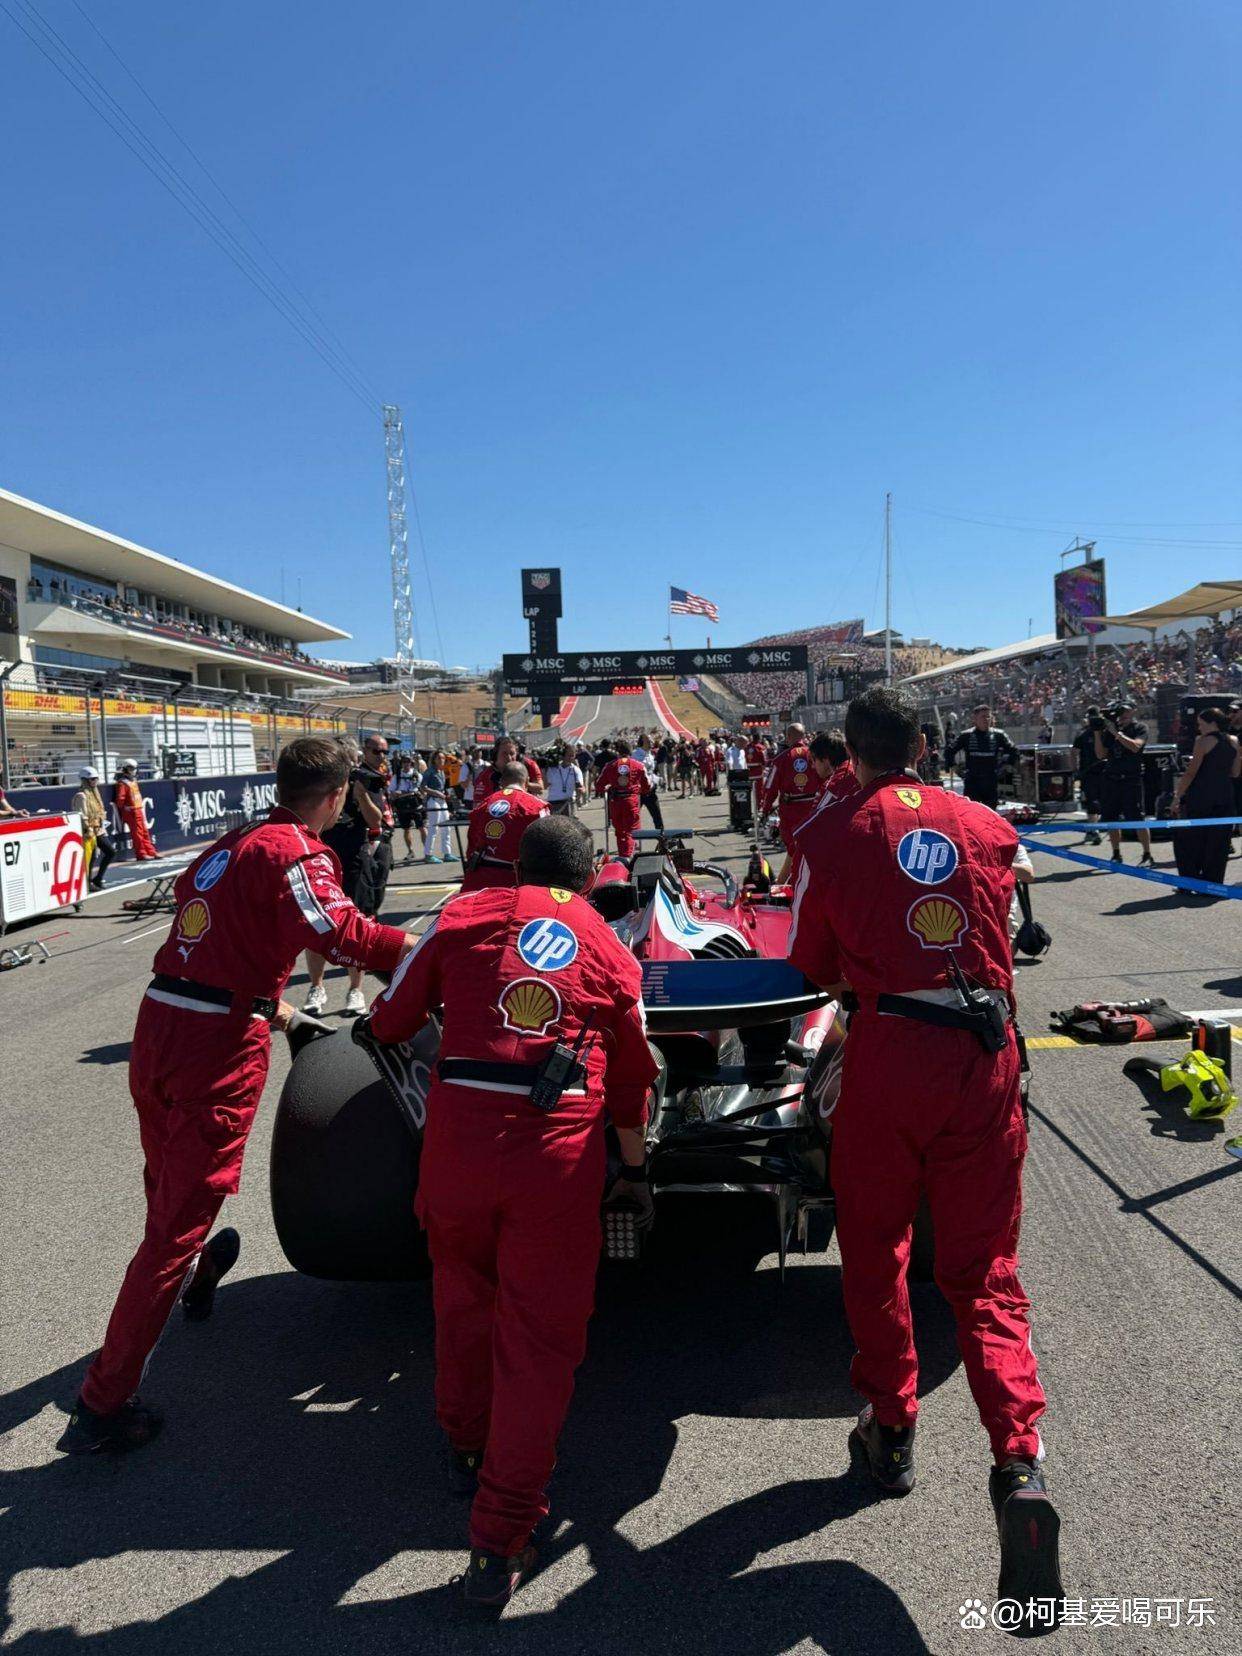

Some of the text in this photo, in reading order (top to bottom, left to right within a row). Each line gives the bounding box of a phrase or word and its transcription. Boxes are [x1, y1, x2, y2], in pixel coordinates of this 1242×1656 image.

[524, 607, 540, 616] LAP
[650, 656, 675, 666] MSC
[706, 654, 731, 664] MSC
[762, 651, 790, 662] MSC
[536, 658, 564, 669] MSC
[593, 657, 621, 668] MSC
[511, 687, 528, 695] TIME
[573, 685, 587, 693] LAP
[254, 783, 279, 811] MSC
[734, 791, 748, 802] 12
[193, 789, 226, 821] MSC
[4, 840, 20, 866] 87
[903, 829, 950, 884] hp
[197, 850, 228, 889] hp
[521, 918, 574, 969] hp
